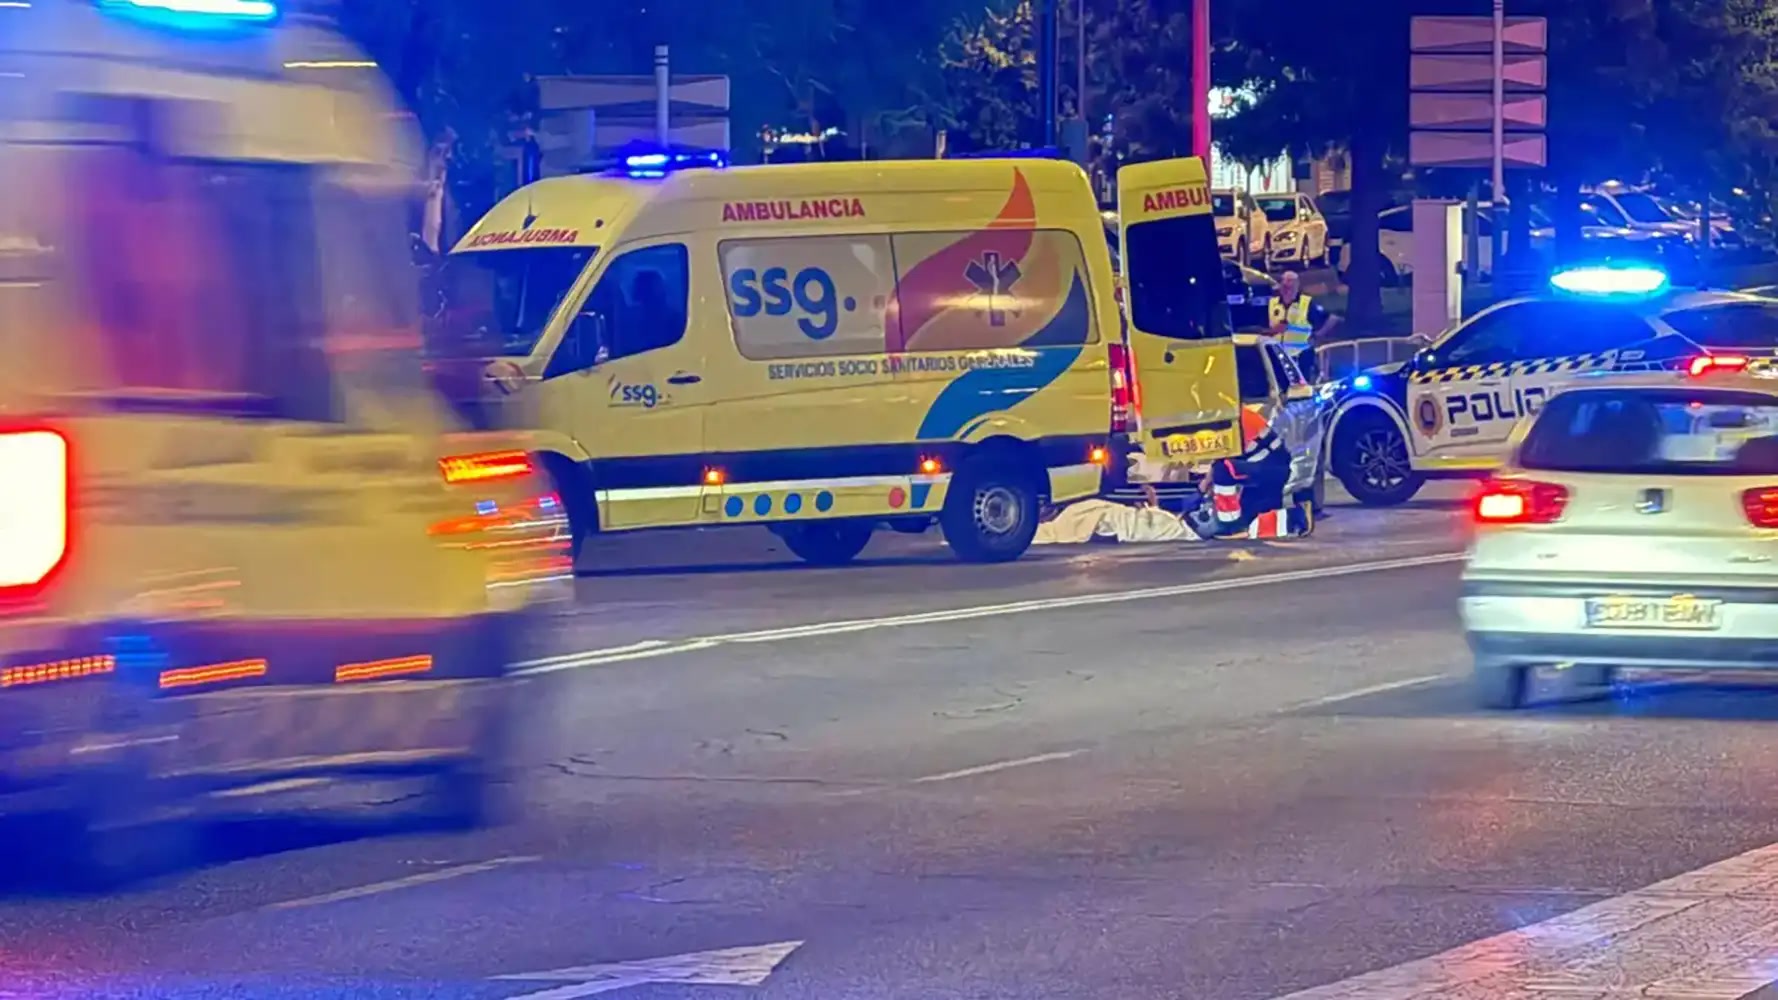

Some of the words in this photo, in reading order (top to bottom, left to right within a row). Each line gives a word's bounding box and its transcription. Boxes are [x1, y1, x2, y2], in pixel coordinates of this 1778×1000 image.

[722, 198, 865, 222] AMBULANCIA
[768, 359, 835, 380] SERVICIOS
[838, 357, 878, 376] SOCIO
[881, 354, 955, 375] SANITARIOS
[1446, 386, 1554, 425] POLIC
